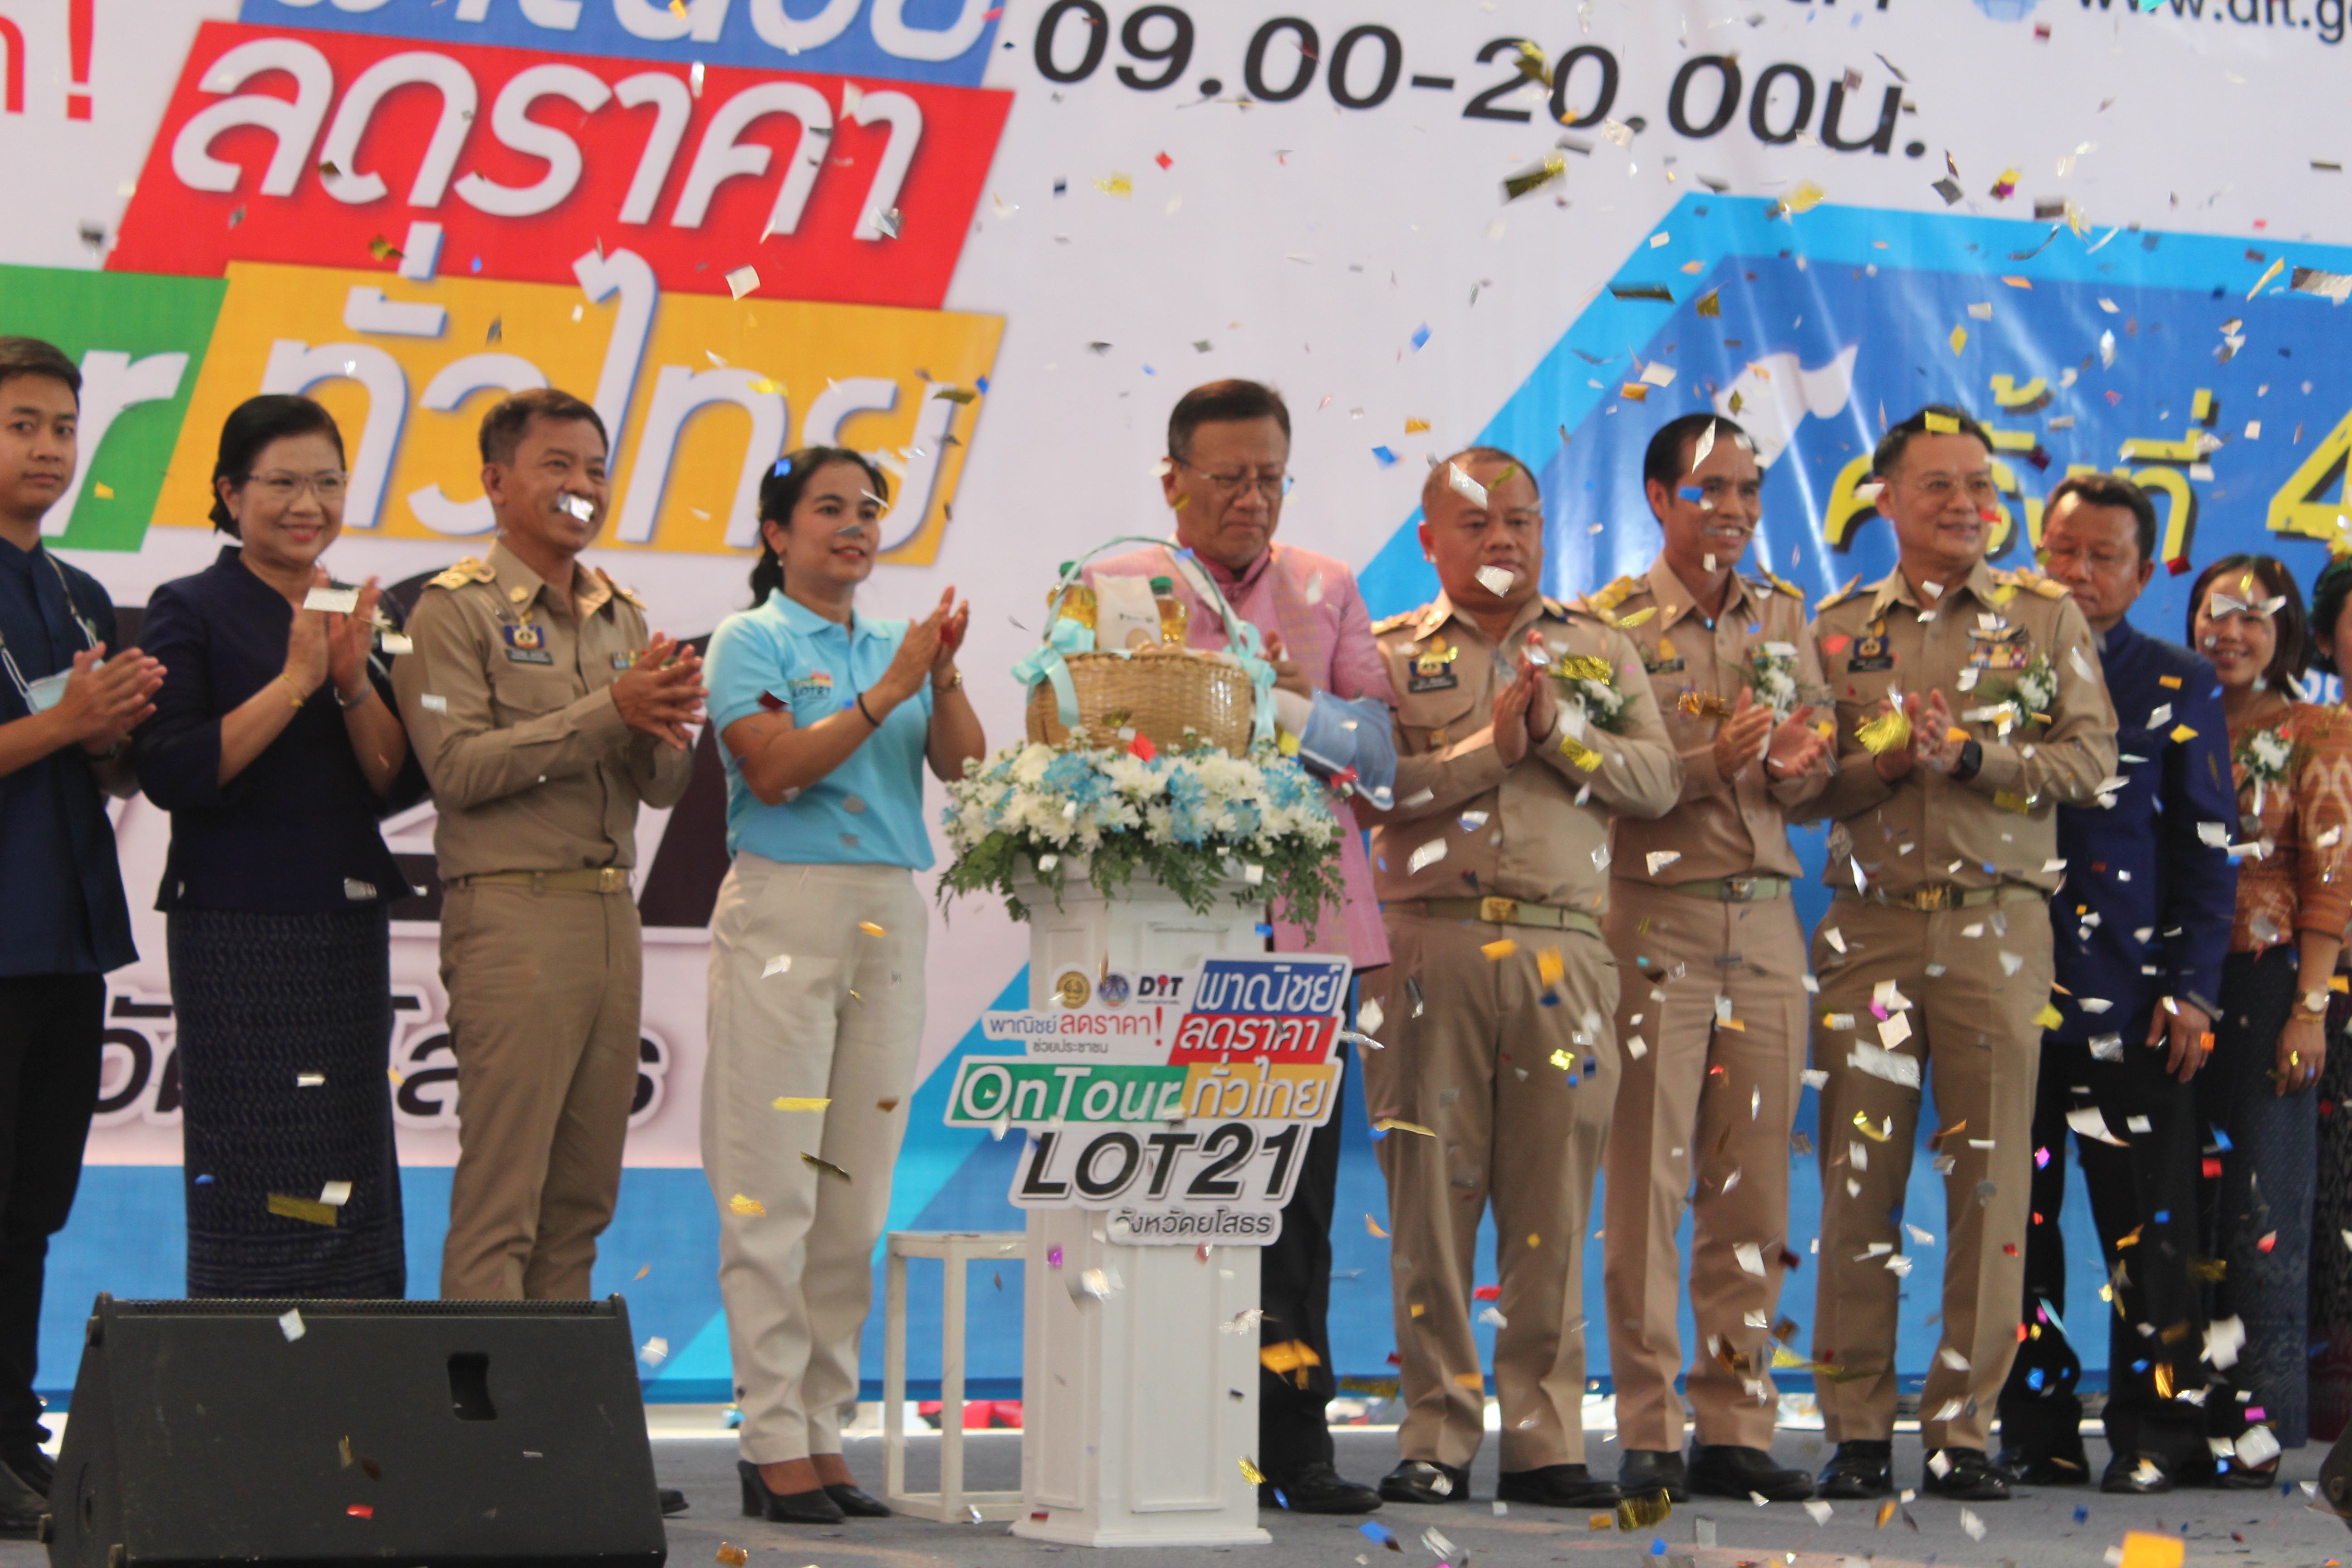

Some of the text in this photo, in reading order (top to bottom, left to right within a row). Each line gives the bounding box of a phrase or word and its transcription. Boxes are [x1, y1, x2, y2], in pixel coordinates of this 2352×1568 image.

[1034, 0, 1926, 157] 09.00-20.00น.
[172, 37, 923, 241] ลดราคา
[1195, 964, 1342, 1012] พาณิชย์
[990, 1015, 1057, 1034] พาณิชย์
[1179, 1017, 1320, 1053] ลดราคา
[1190, 1053, 1328, 1118] ทั่วไทย
